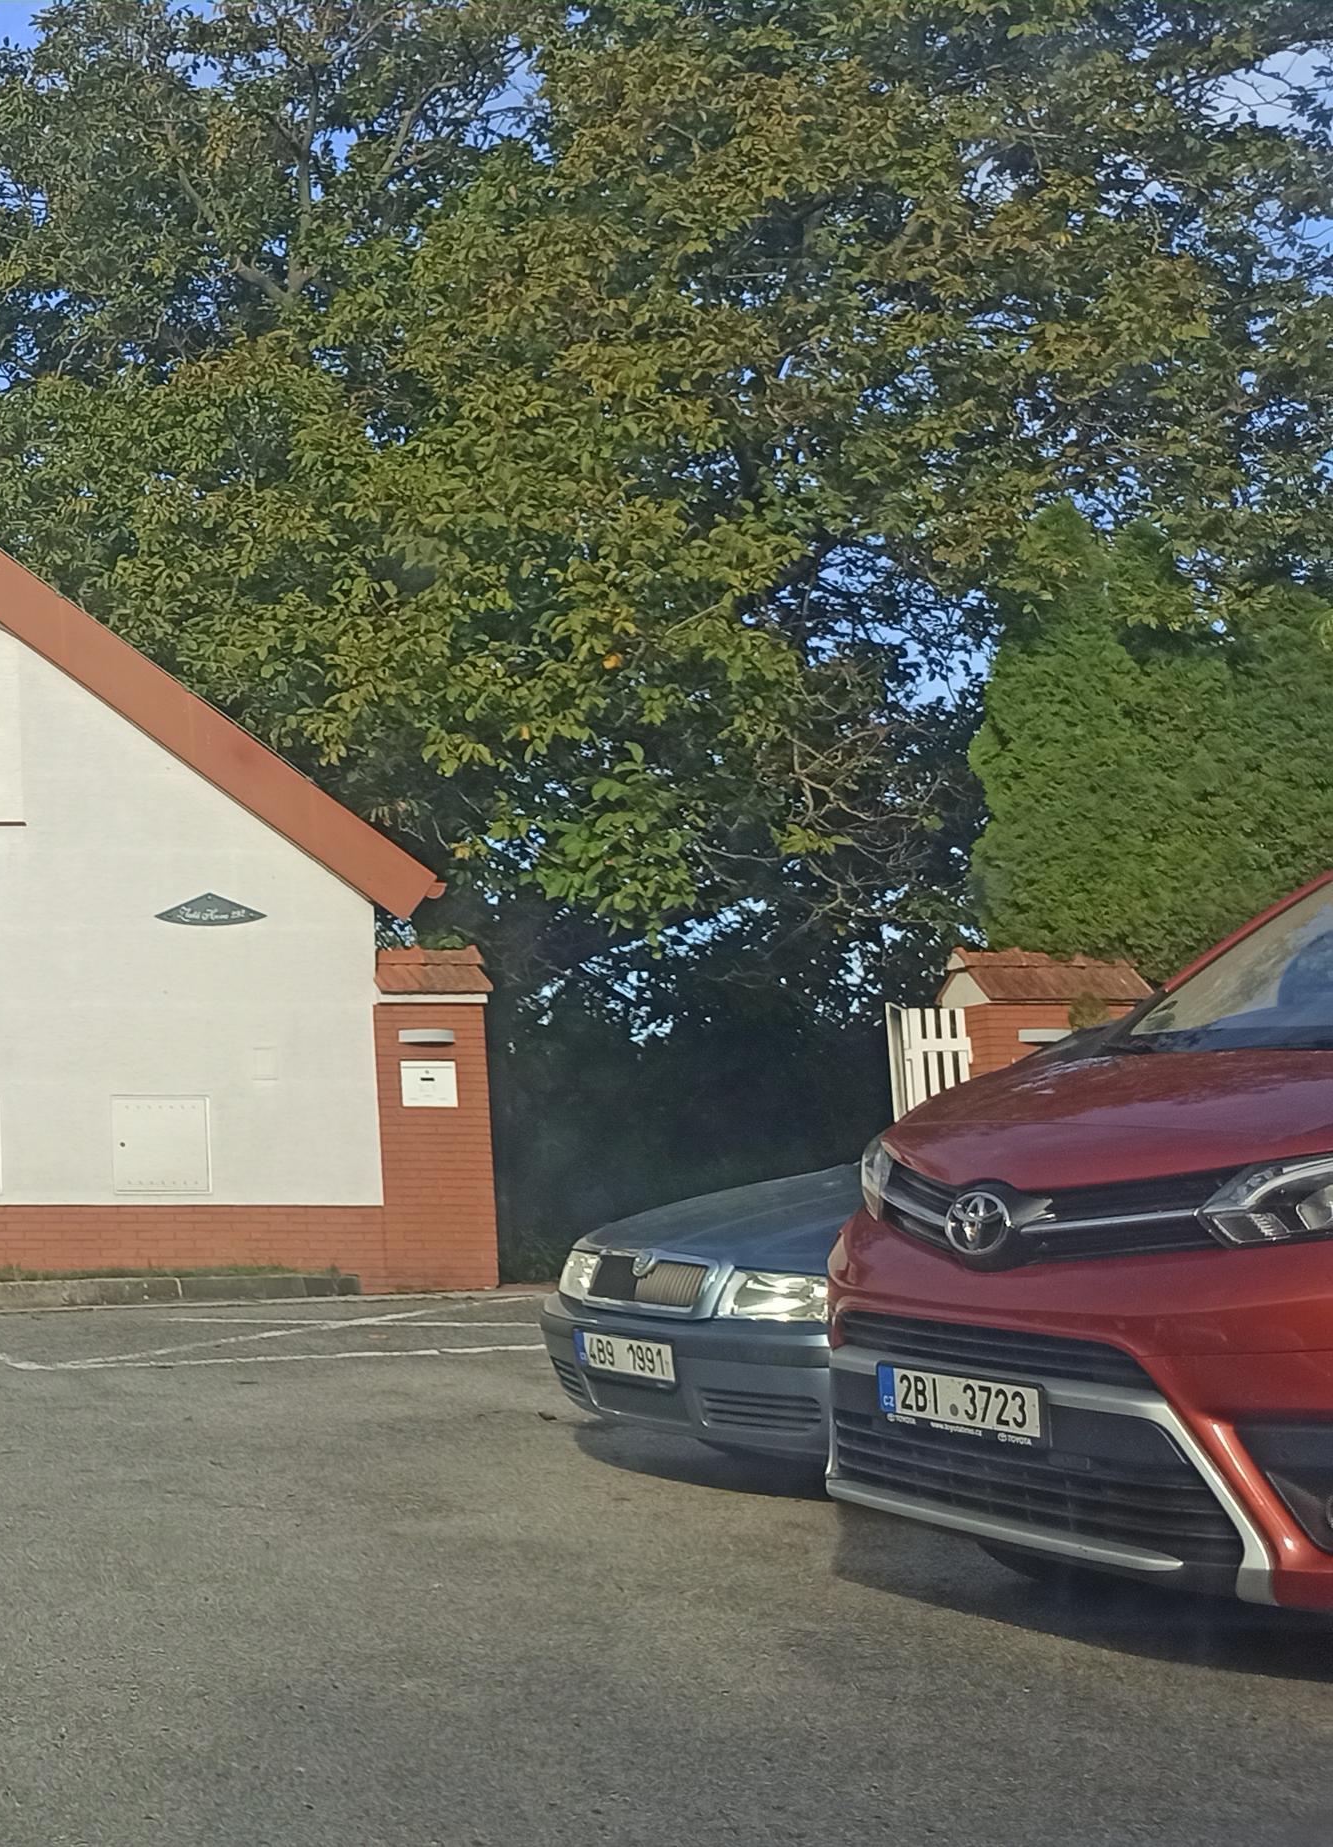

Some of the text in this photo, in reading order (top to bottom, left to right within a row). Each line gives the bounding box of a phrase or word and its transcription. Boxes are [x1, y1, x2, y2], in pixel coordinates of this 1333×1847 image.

[589, 1338, 666, 1376] 4B9 1991
[883, 1395, 894, 1407] CZ
[963, 1383, 1027, 1429] 3723
[1008, 1434, 1032, 1446] TOYOTA
